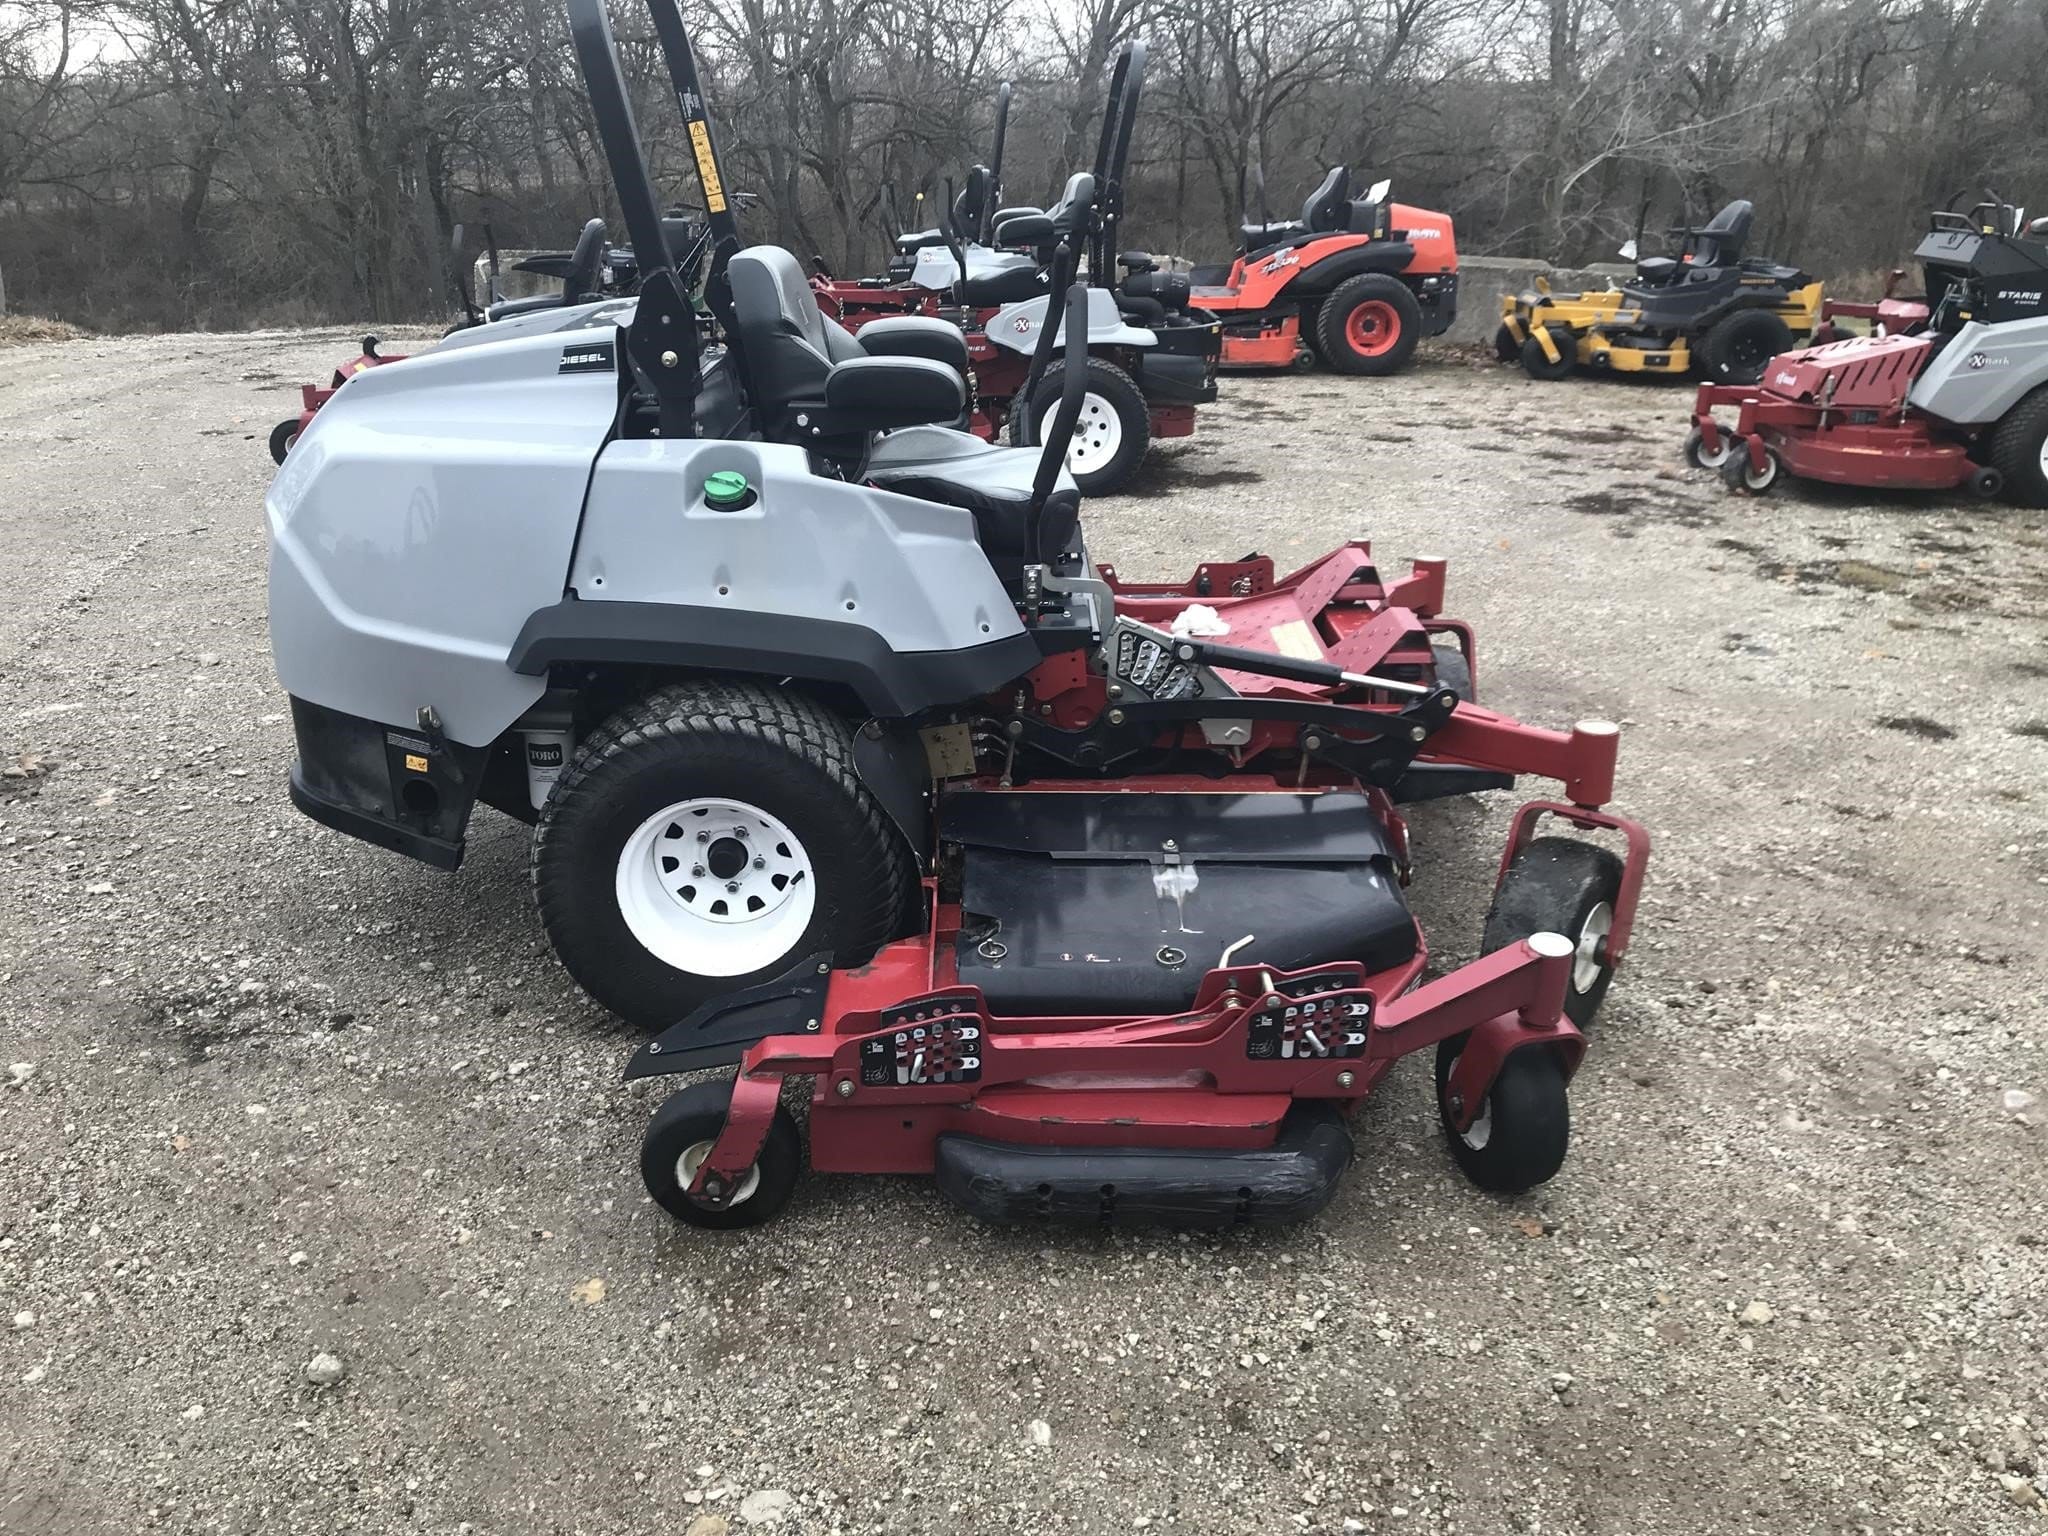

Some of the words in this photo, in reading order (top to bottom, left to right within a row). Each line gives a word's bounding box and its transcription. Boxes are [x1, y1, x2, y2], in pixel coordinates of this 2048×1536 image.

[1997, 290, 2042, 300] STARIS
[1013, 317, 1044, 333] eXmar
[560, 353, 607, 365] DIESEL
[530, 750, 560, 761] TORO
